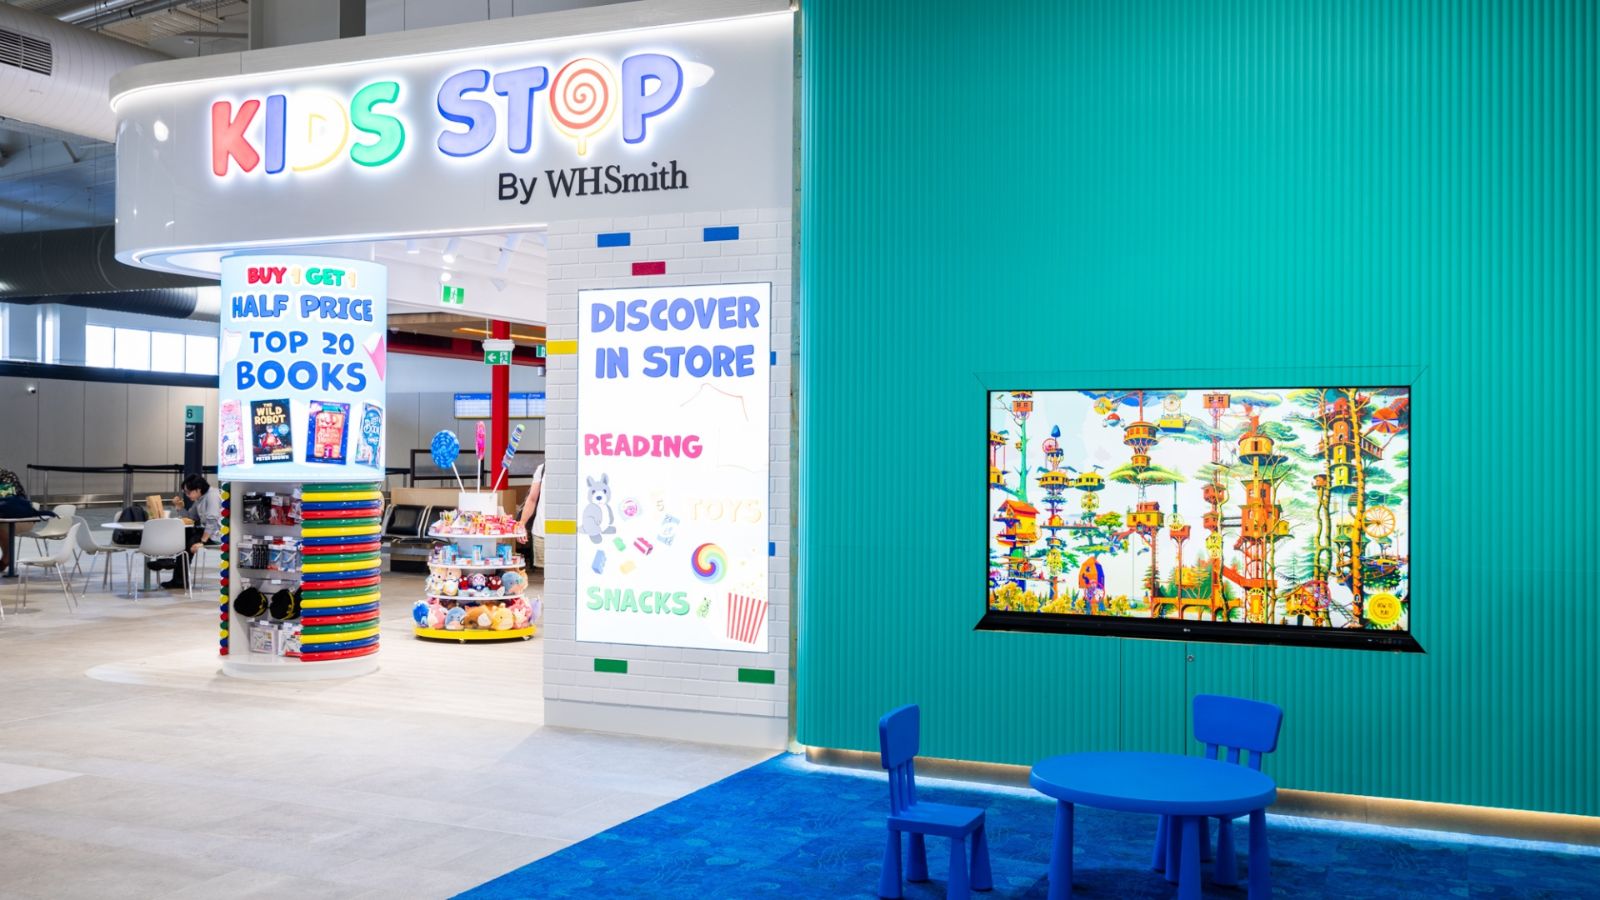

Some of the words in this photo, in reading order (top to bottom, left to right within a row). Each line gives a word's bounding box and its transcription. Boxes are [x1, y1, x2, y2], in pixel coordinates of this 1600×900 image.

[212, 81, 406, 177] KIDS
[437, 53, 683, 157] STOP
[499, 172, 538, 205] By
[545, 160, 688, 199] WHSmith
[247, 267, 287, 284] BUY
[291, 267, 301, 285] 1
[305, 268, 345, 286] GET
[232, 294, 289, 318] HALF
[300, 295, 373, 322] PRICE
[591, 296, 761, 333] DISCOVER
[249, 331, 308, 354] TOP
[322, 332, 355, 355] 20
[595, 347, 629, 379] IN
[642, 344, 755, 378] STORE
[236, 360, 367, 392] BOOKS
[186, 408, 193, 419] 6
[254, 414, 286, 425] ROBOT
[256, 406, 283, 416] WILD
[584, 433, 703, 459] READING
[688, 498, 762, 525] TOYS
[586, 586, 691, 616] SNACKS
